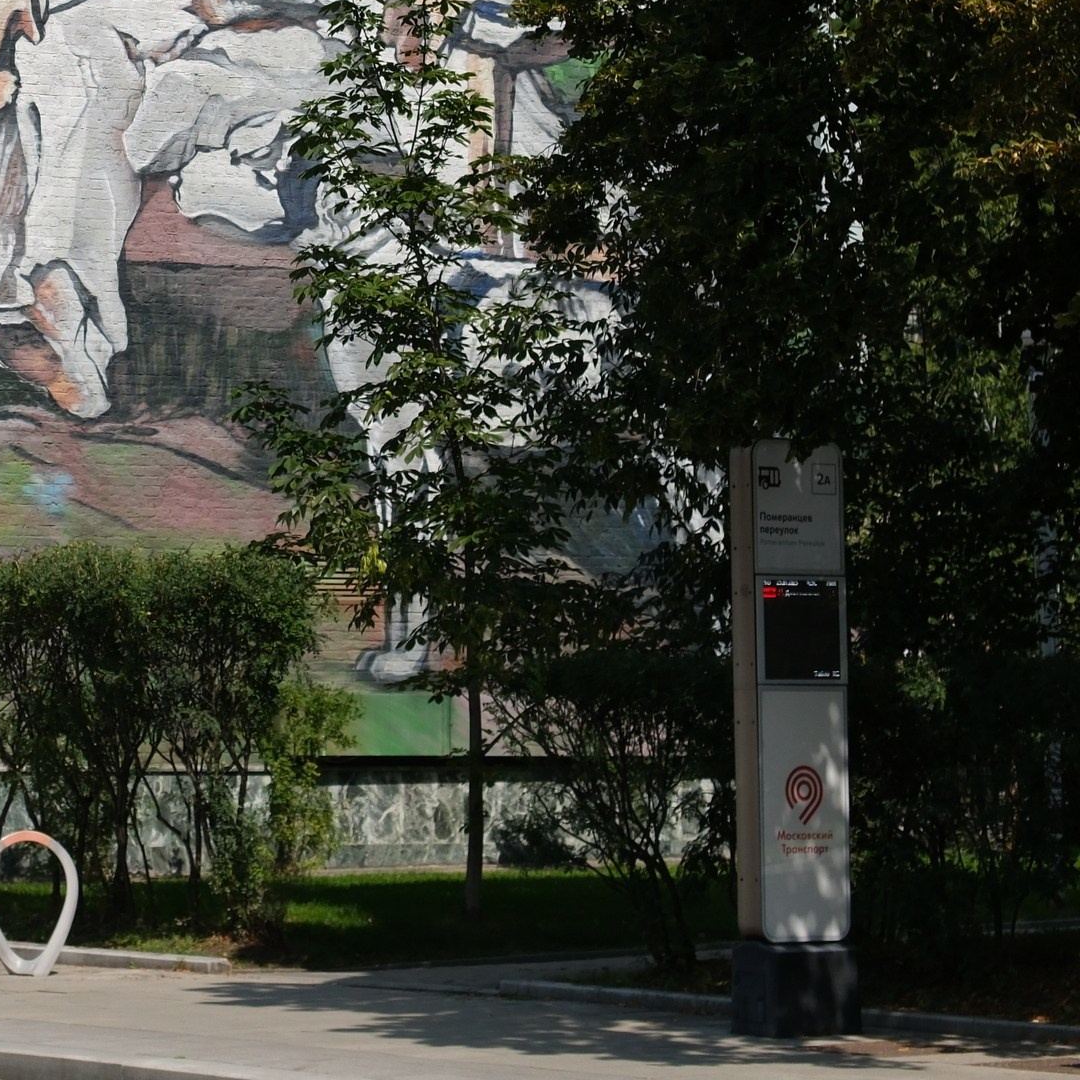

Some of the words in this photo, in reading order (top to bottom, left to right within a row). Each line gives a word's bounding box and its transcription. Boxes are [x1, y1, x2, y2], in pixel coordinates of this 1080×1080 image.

[760, 512, 813, 523] Померанцев
[760, 526, 799, 536] переулок
[777, 830, 833, 840] Московский
[782, 844, 829, 856] Транспорт
